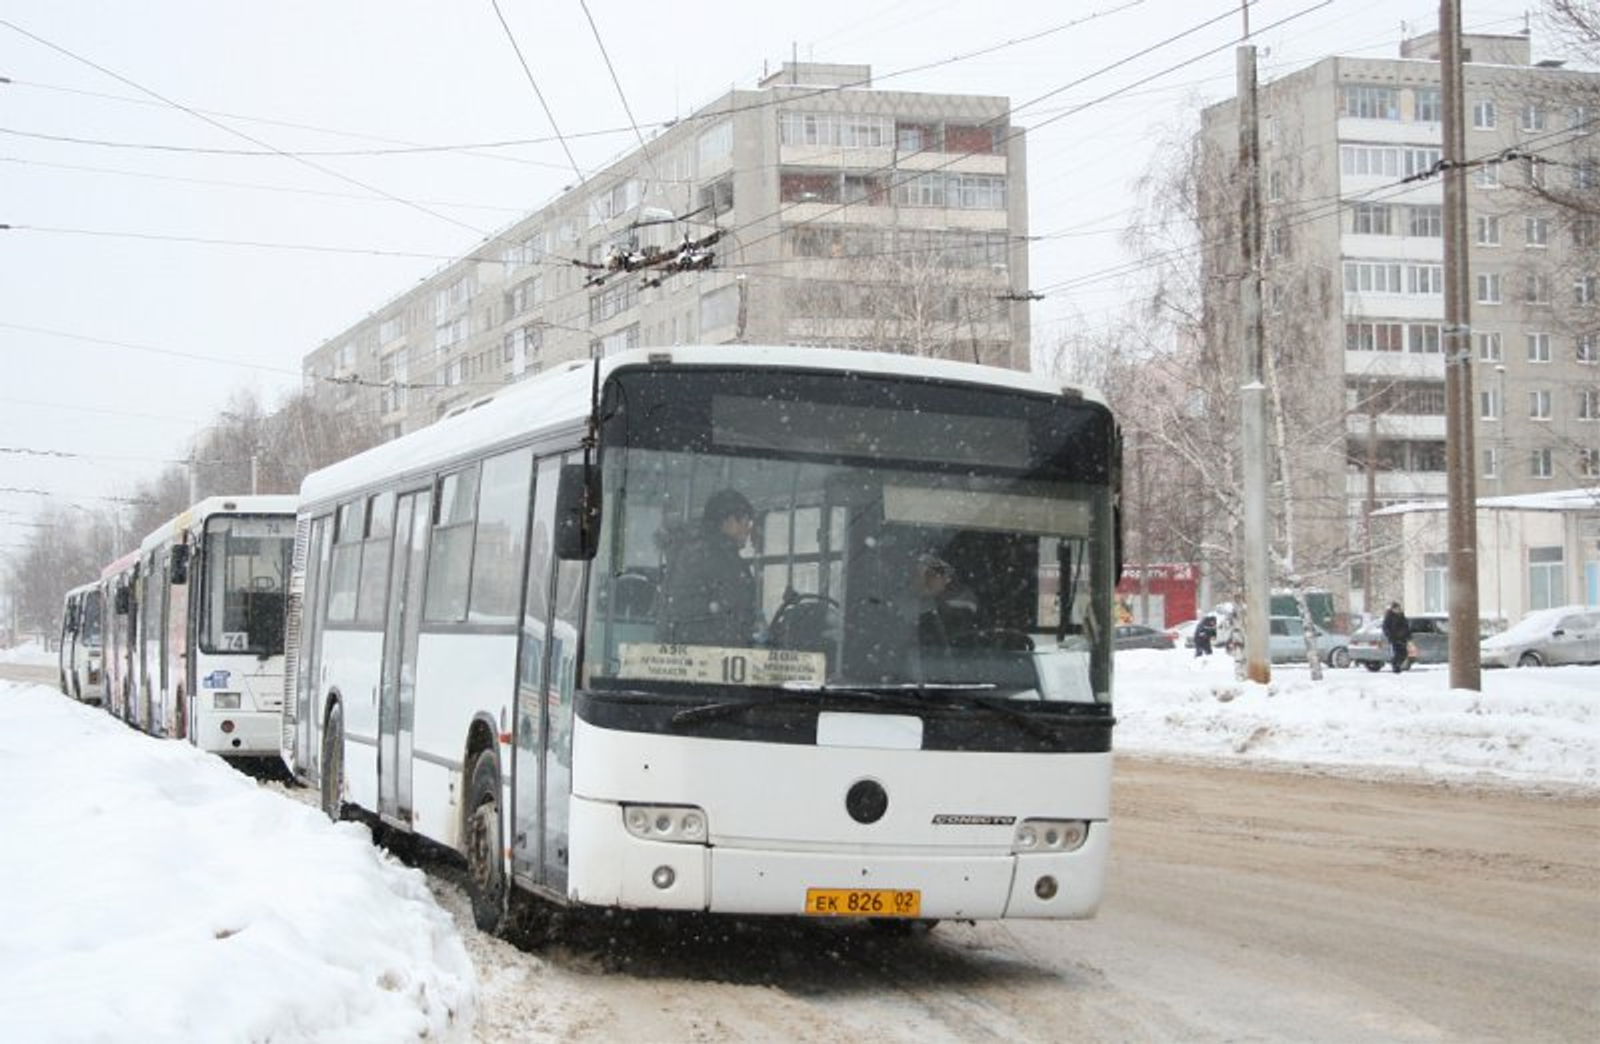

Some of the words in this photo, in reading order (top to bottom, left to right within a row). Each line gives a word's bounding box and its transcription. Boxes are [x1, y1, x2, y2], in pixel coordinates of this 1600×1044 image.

[224, 633, 244, 649] 74
[721, 656, 746, 684] 10
[933, 815, 1016, 825] CONECTO
[848, 892, 883, 911] 826
[894, 892, 913, 907] 02
